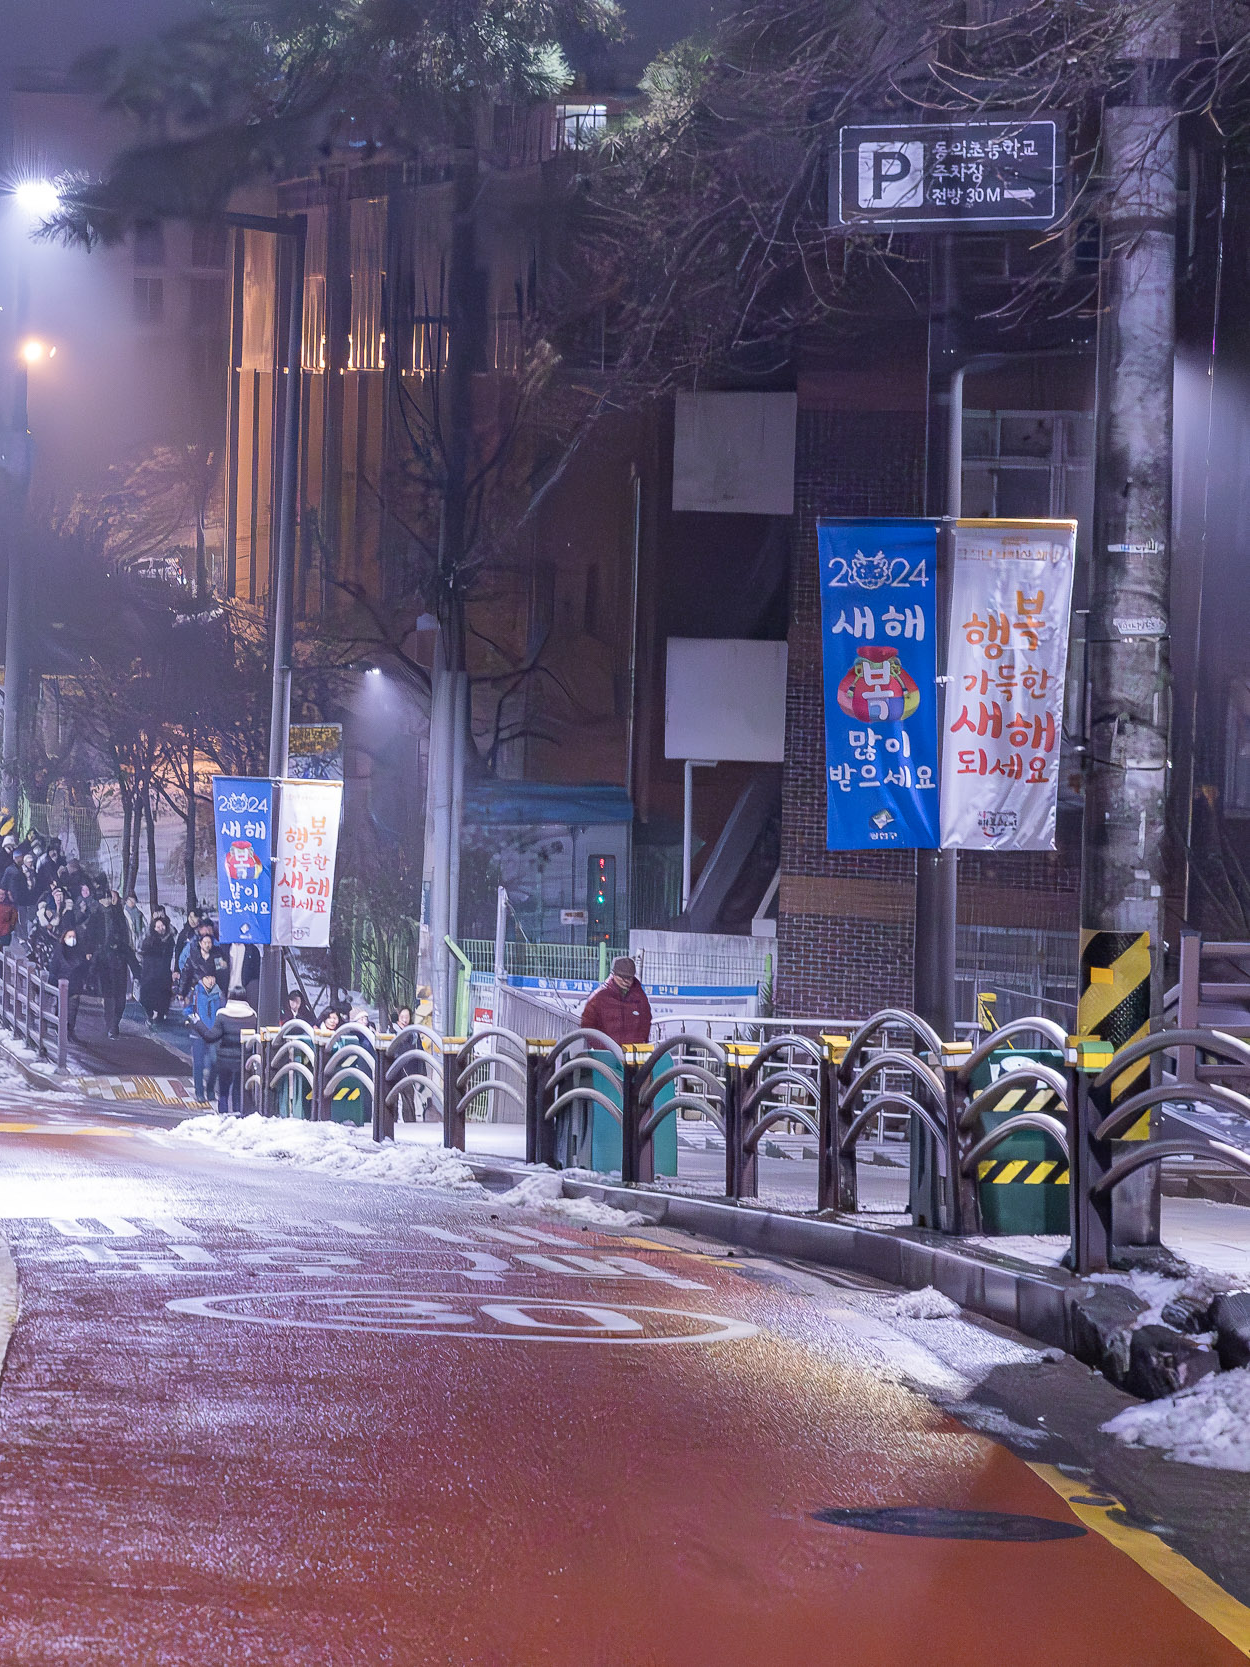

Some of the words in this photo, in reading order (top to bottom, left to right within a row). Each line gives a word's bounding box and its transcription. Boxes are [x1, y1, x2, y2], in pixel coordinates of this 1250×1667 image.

[932, 138, 1039, 159] 동의초등학교
[873, 151, 911, 200] P
[932, 163, 985, 183] 주차장
[932, 187, 963, 205] 전방
[832, 604, 925, 641] 새해
[962, 589, 1046, 660] 행복
[862, 660, 894, 720] 복
[963, 665, 1055, 702] 가득한
[950, 701, 1055, 752] 새해
[849, 727, 911, 761] 많이
[830, 761, 936, 792] 받으세요
[957, 749, 1049, 784] 되세요
[221, 820, 266, 840] 새해
[285, 816, 326, 851] 행복
[233, 847, 250, 879] 복
[285, 853, 331, 872] 가득한
[229, 882, 259, 900] 많이
[277, 871, 330, 898] 새해
[219, 899, 270, 915] 받으세요
[280, 894, 327, 913] 되세요
[66, 1243, 715, 1291] 보호구역
[306, 1297, 645, 1332] 30
